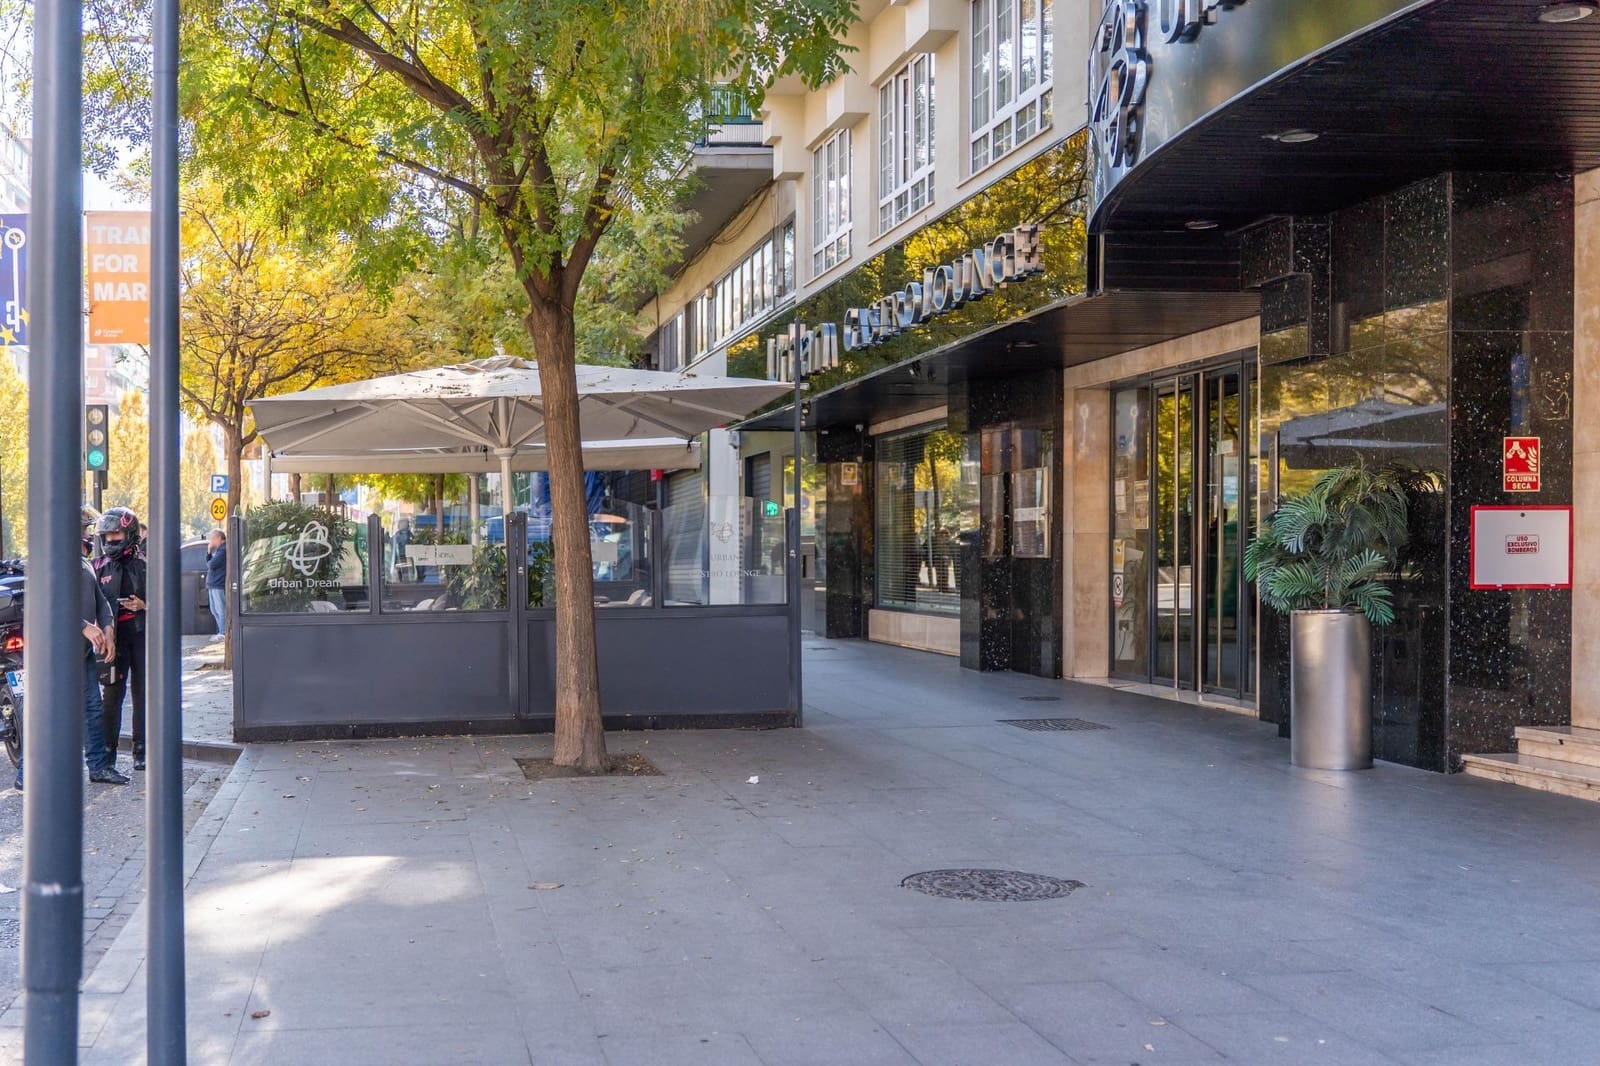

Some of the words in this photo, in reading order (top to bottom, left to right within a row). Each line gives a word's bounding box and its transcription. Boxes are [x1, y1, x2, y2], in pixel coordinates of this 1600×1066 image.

[93, 254, 138, 273] FOR
[1506, 475, 1537, 483] COLUMNA
[212, 476, 225, 492] P
[1512, 482, 1531, 490] SECA
[214, 505, 225, 514] 20
[269, 579, 303, 589] Urban
